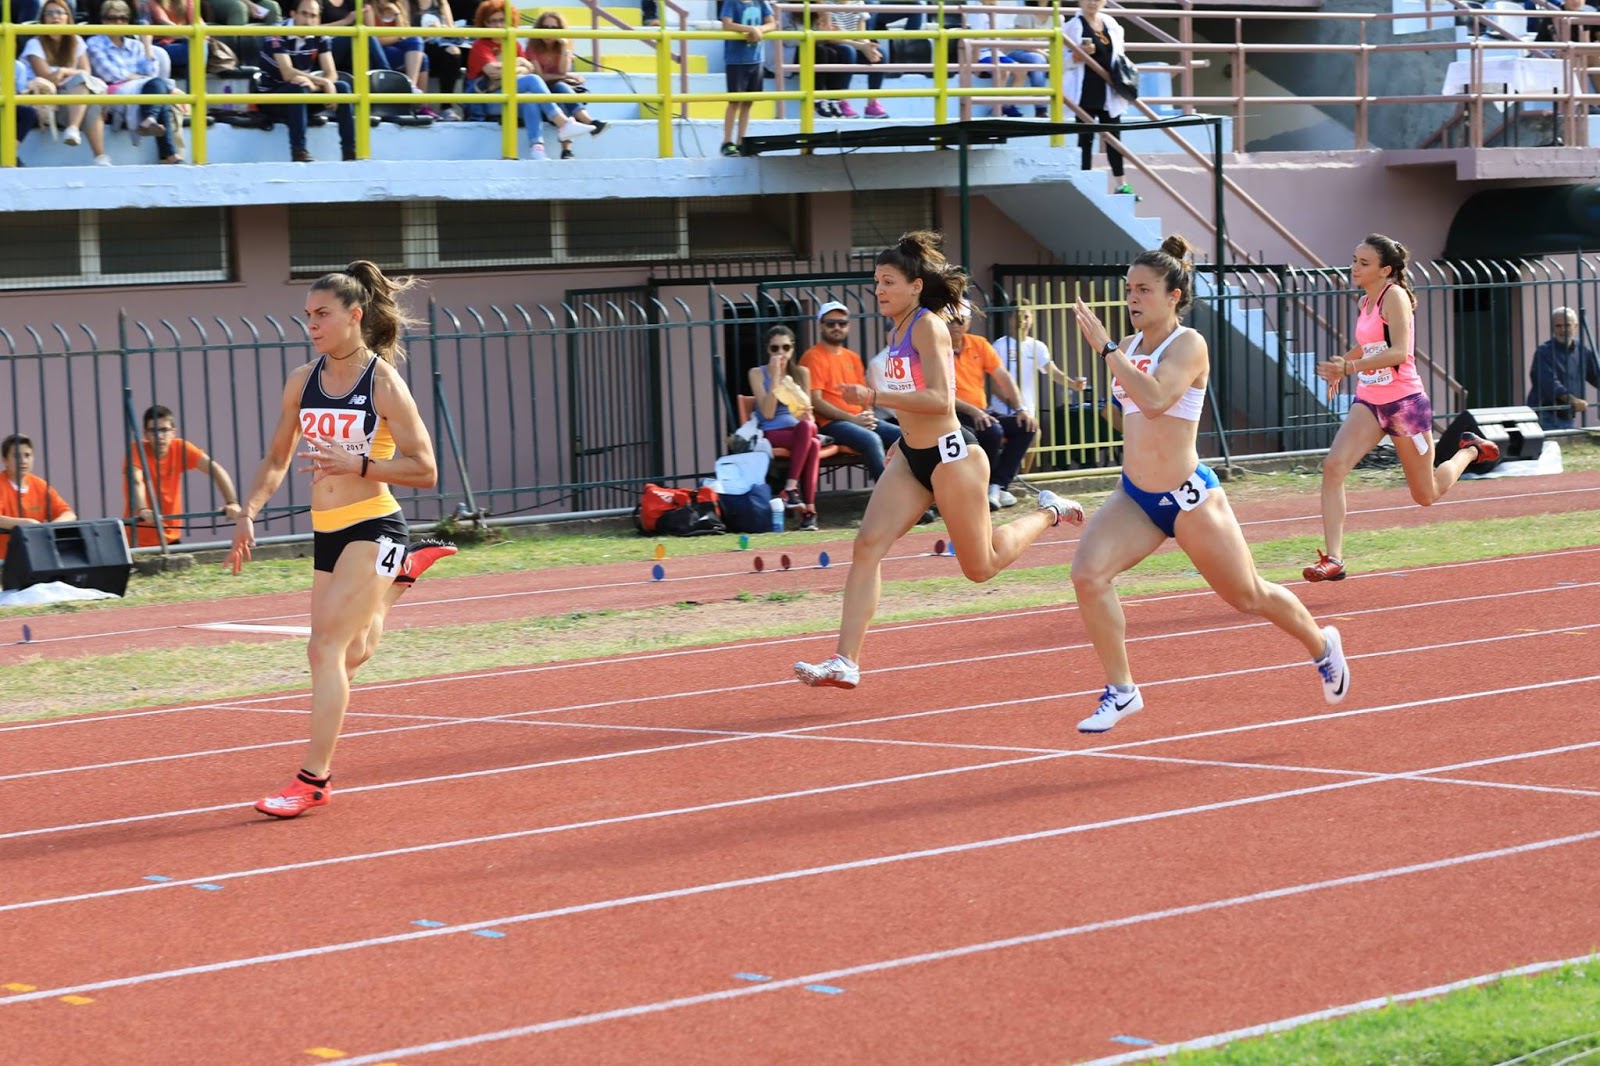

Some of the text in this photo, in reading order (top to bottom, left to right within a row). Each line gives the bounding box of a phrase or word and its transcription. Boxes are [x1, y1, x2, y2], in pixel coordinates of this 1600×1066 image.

[884, 357, 906, 380] 08
[302, 412, 358, 439] 207
[346, 443, 364, 451] 2017
[945, 434, 961, 458] 5
[1179, 480, 1201, 505] 3
[381, 546, 397, 573] 4
